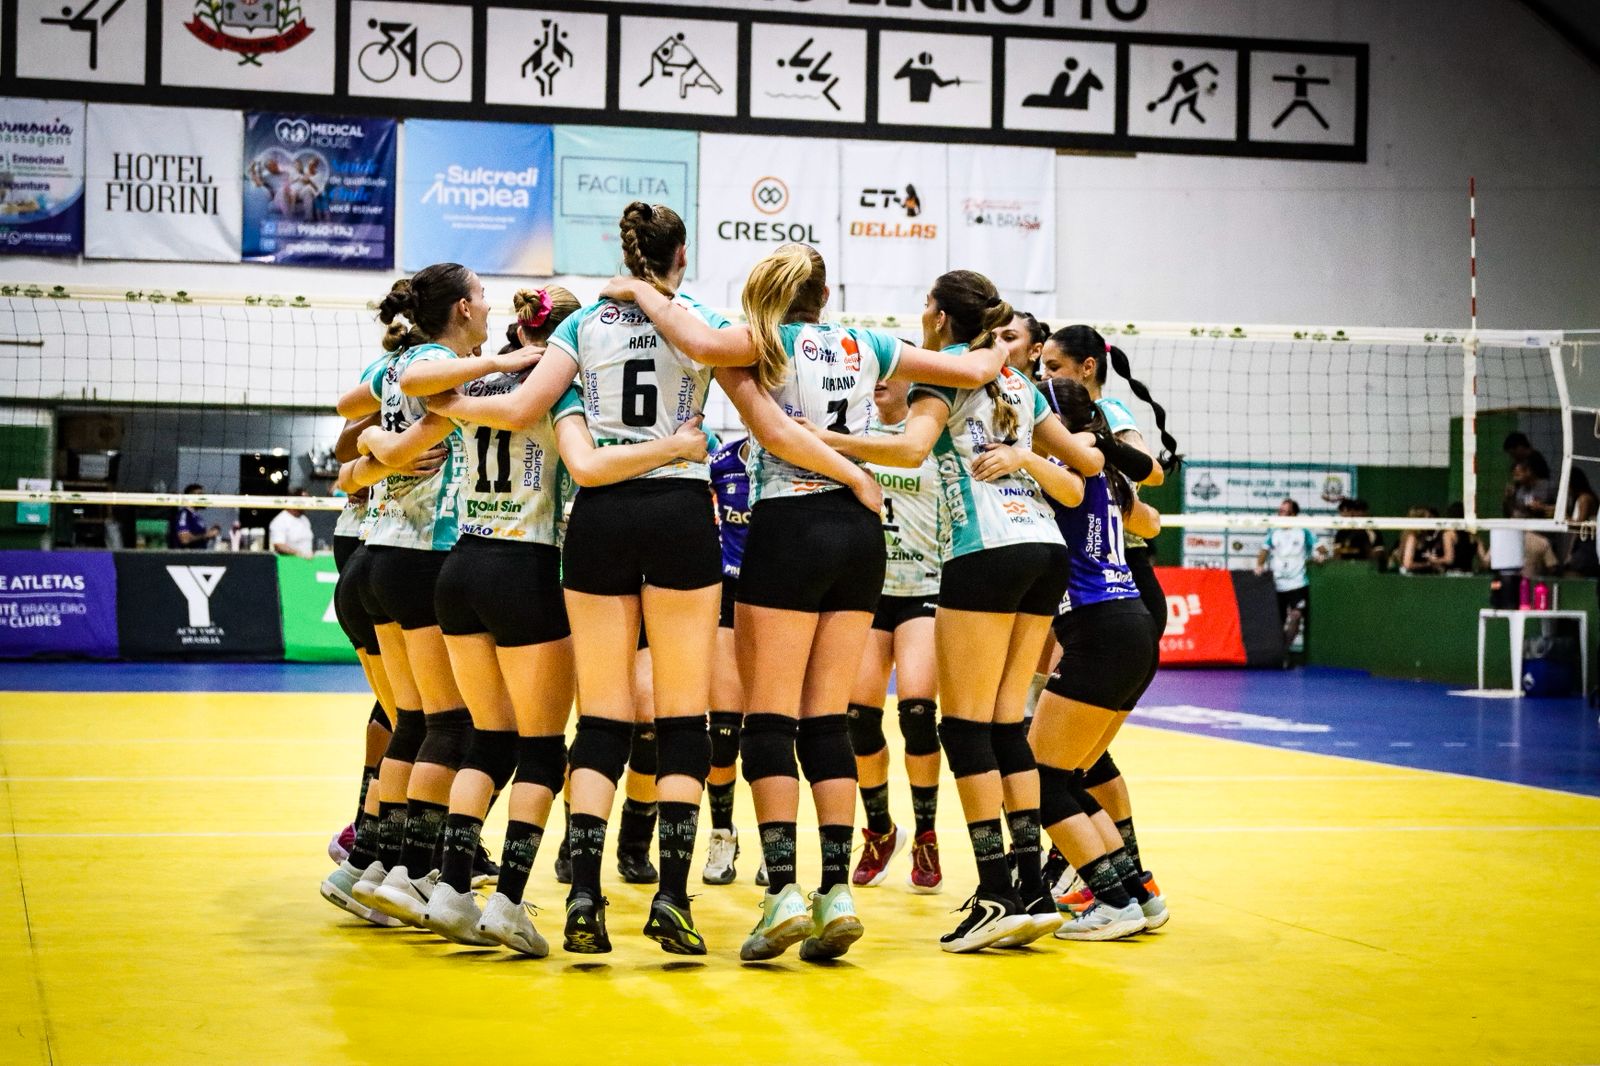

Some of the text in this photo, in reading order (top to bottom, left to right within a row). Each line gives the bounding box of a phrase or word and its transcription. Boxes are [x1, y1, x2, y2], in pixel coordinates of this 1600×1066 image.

[310, 123, 365, 138] MEDICAL
[310, 135, 351, 149] HOUSE
[113, 152, 213, 185] HOTEL
[577, 173, 670, 196] FACILITA
[105, 182, 219, 216] FIORINI
[718, 220, 821, 244] CRESOL
[849, 221, 938, 239] DELLAS
[629, 335, 657, 350] RAFA
[621, 359, 658, 427] 6
[474, 426, 512, 493] 11
[500, 500, 522, 513] Sin
[10, 574, 86, 591] ATLETAS
[20, 602, 88, 616] BRASILEIRO
[9, 613, 62, 629] CLUBES
